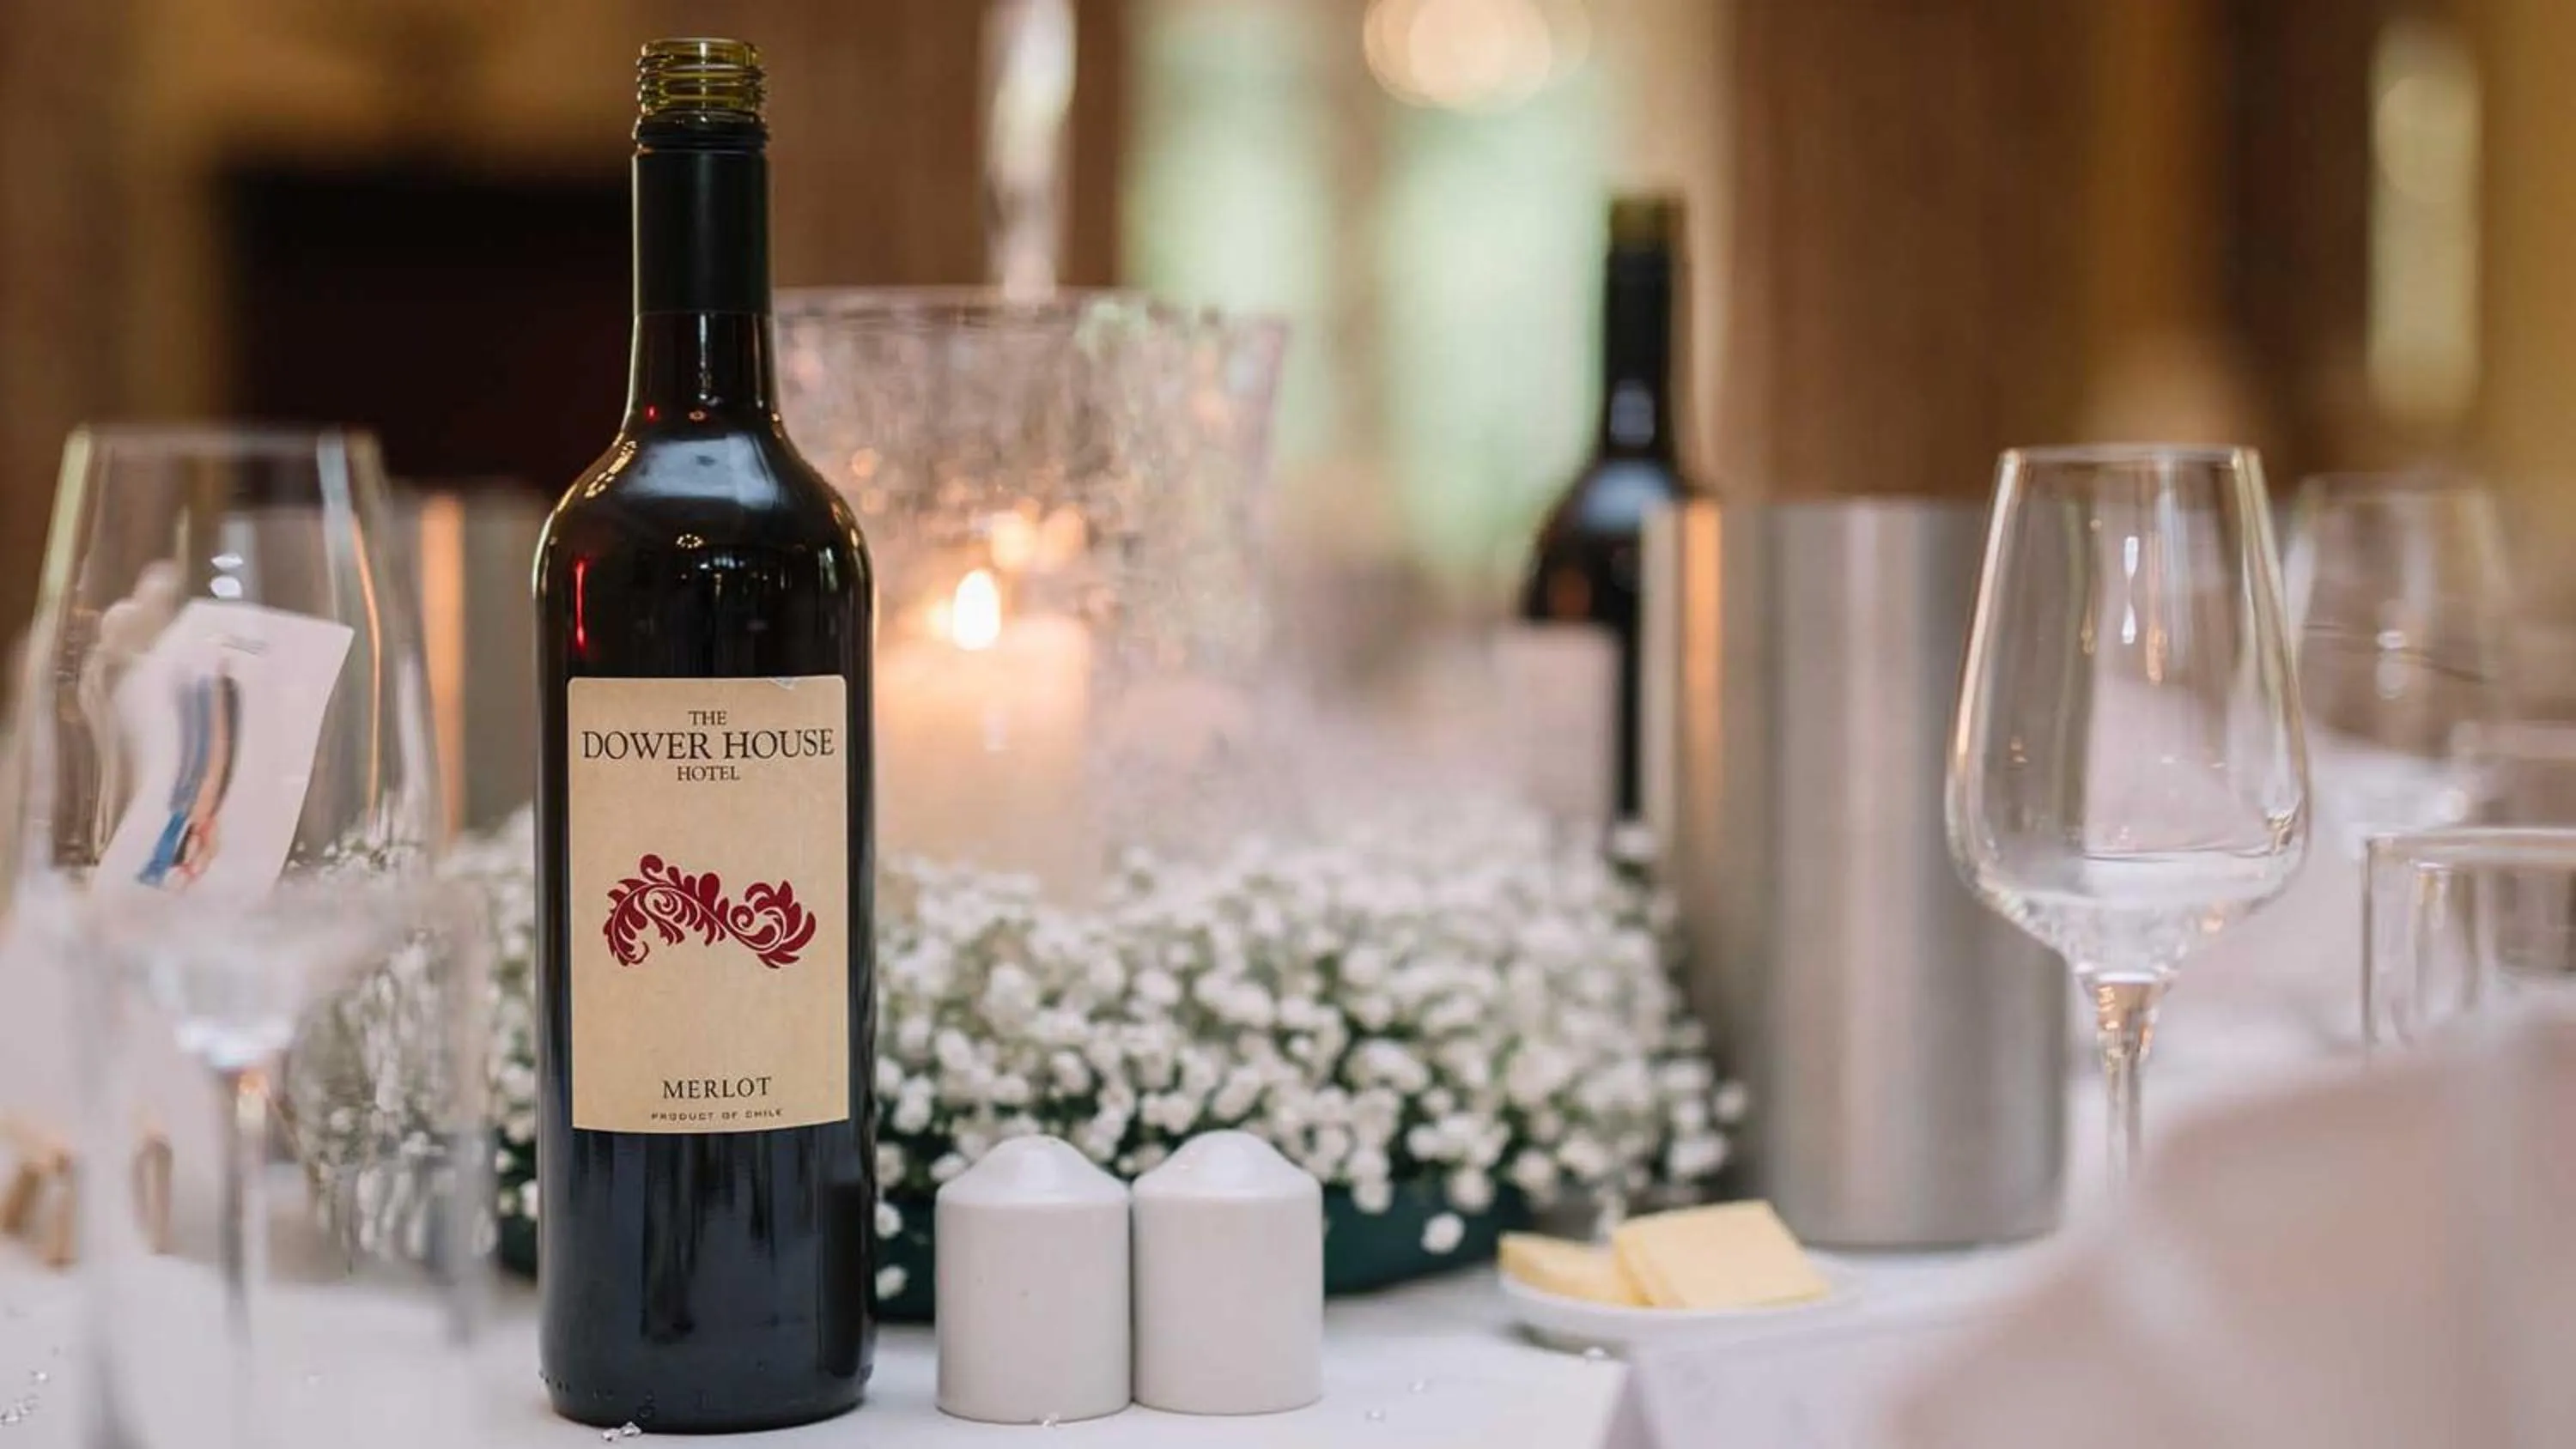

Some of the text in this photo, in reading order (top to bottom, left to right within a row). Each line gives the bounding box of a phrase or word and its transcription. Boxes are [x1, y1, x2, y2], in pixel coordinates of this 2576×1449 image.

[688, 710, 727, 727] THE
[582, 729, 835, 761] DOWER HOUSE
[677, 765, 741, 782] HOTEL
[663, 1076, 773, 1100] MERLOT
[651, 1108, 782, 1121] PRODUCT OF CHILE
